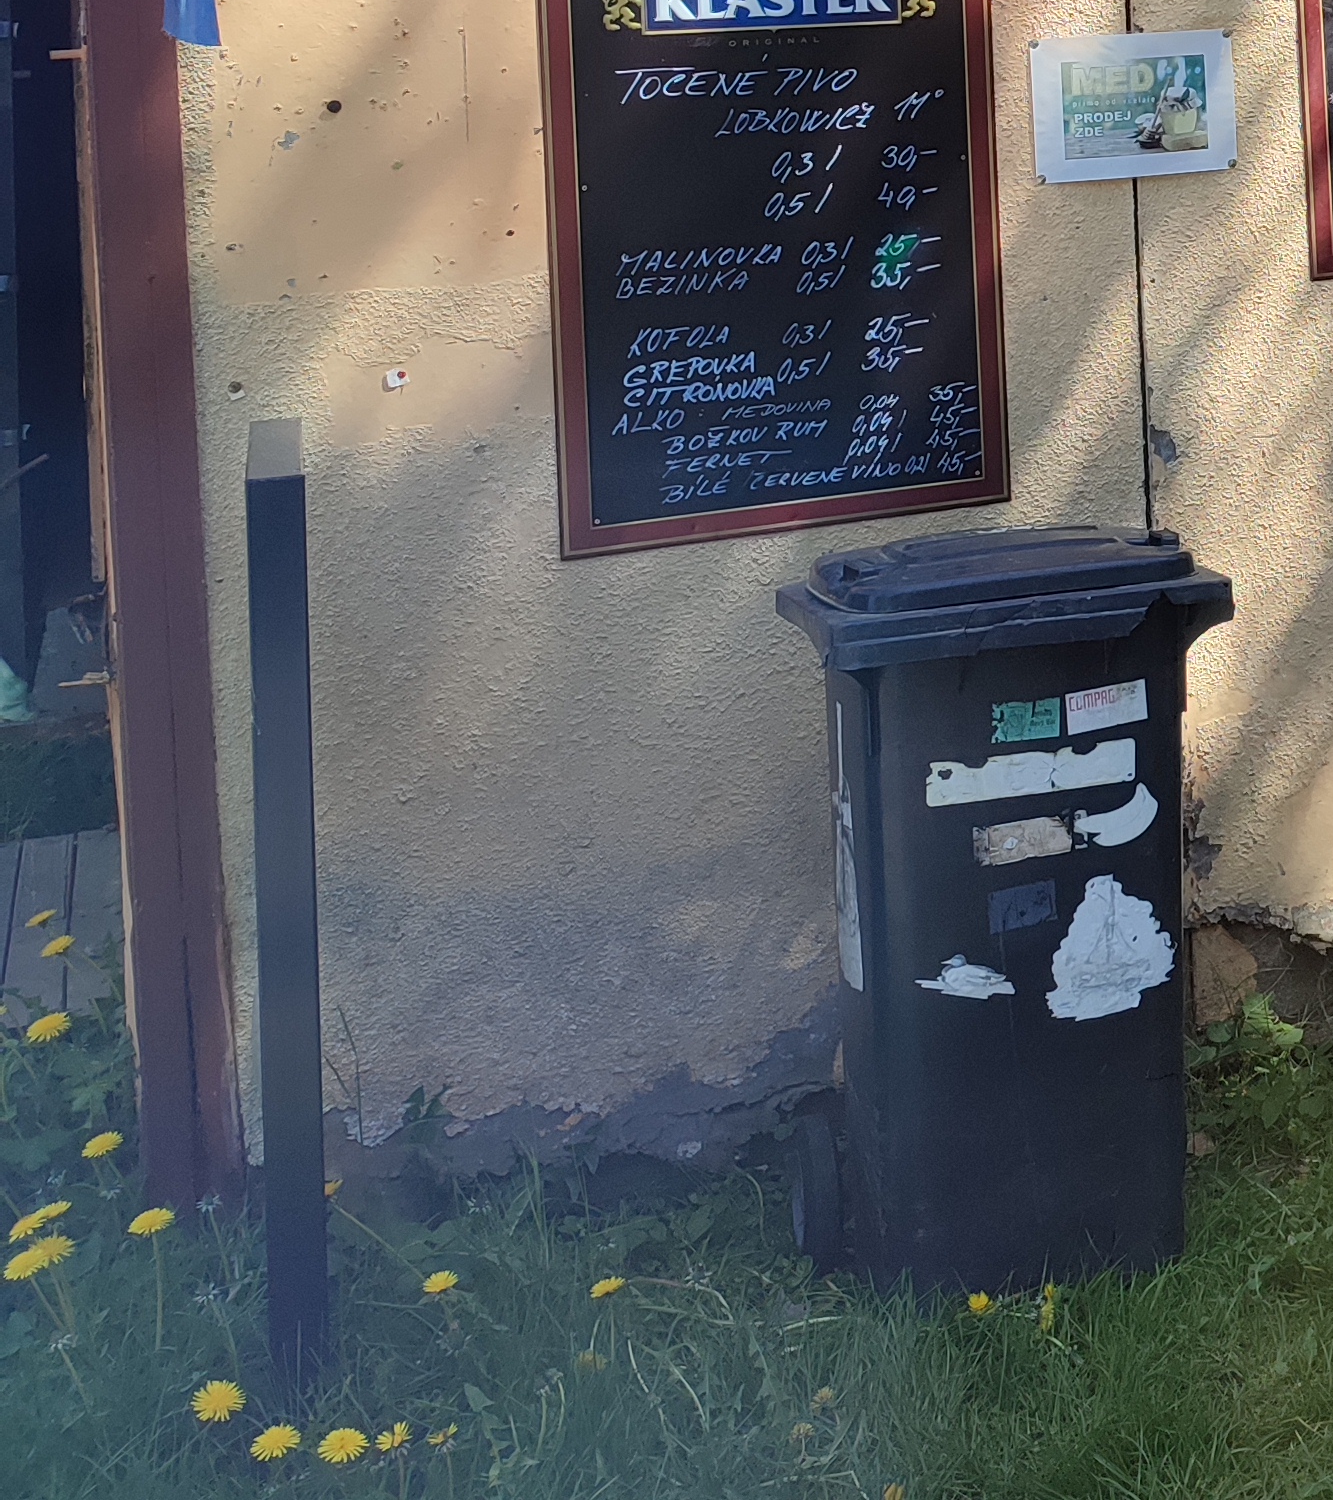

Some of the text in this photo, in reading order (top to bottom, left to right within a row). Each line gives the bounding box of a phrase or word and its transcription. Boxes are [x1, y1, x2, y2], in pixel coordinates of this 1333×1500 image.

[728, 35, 821, 47] ORIGINAL
[774, 67, 858, 95] PIVO
[1071, 62, 1154, 96] MED
[1074, 110, 1132, 124] PRODEJ
[1074, 127, 1104, 138] ZDE
[615, 243, 783, 277] MALINOVKA
[615, 268, 749, 299] BEZINKA
[627, 324, 730, 358] KOFOLA
[623, 351, 757, 388] GREPOVKA
[722, 398, 831, 421] MEDOVINA
[775, 419, 827, 441] RUM
[662, 450, 792, 478] FERNET
[659, 471, 730, 504] BÍLÉ
